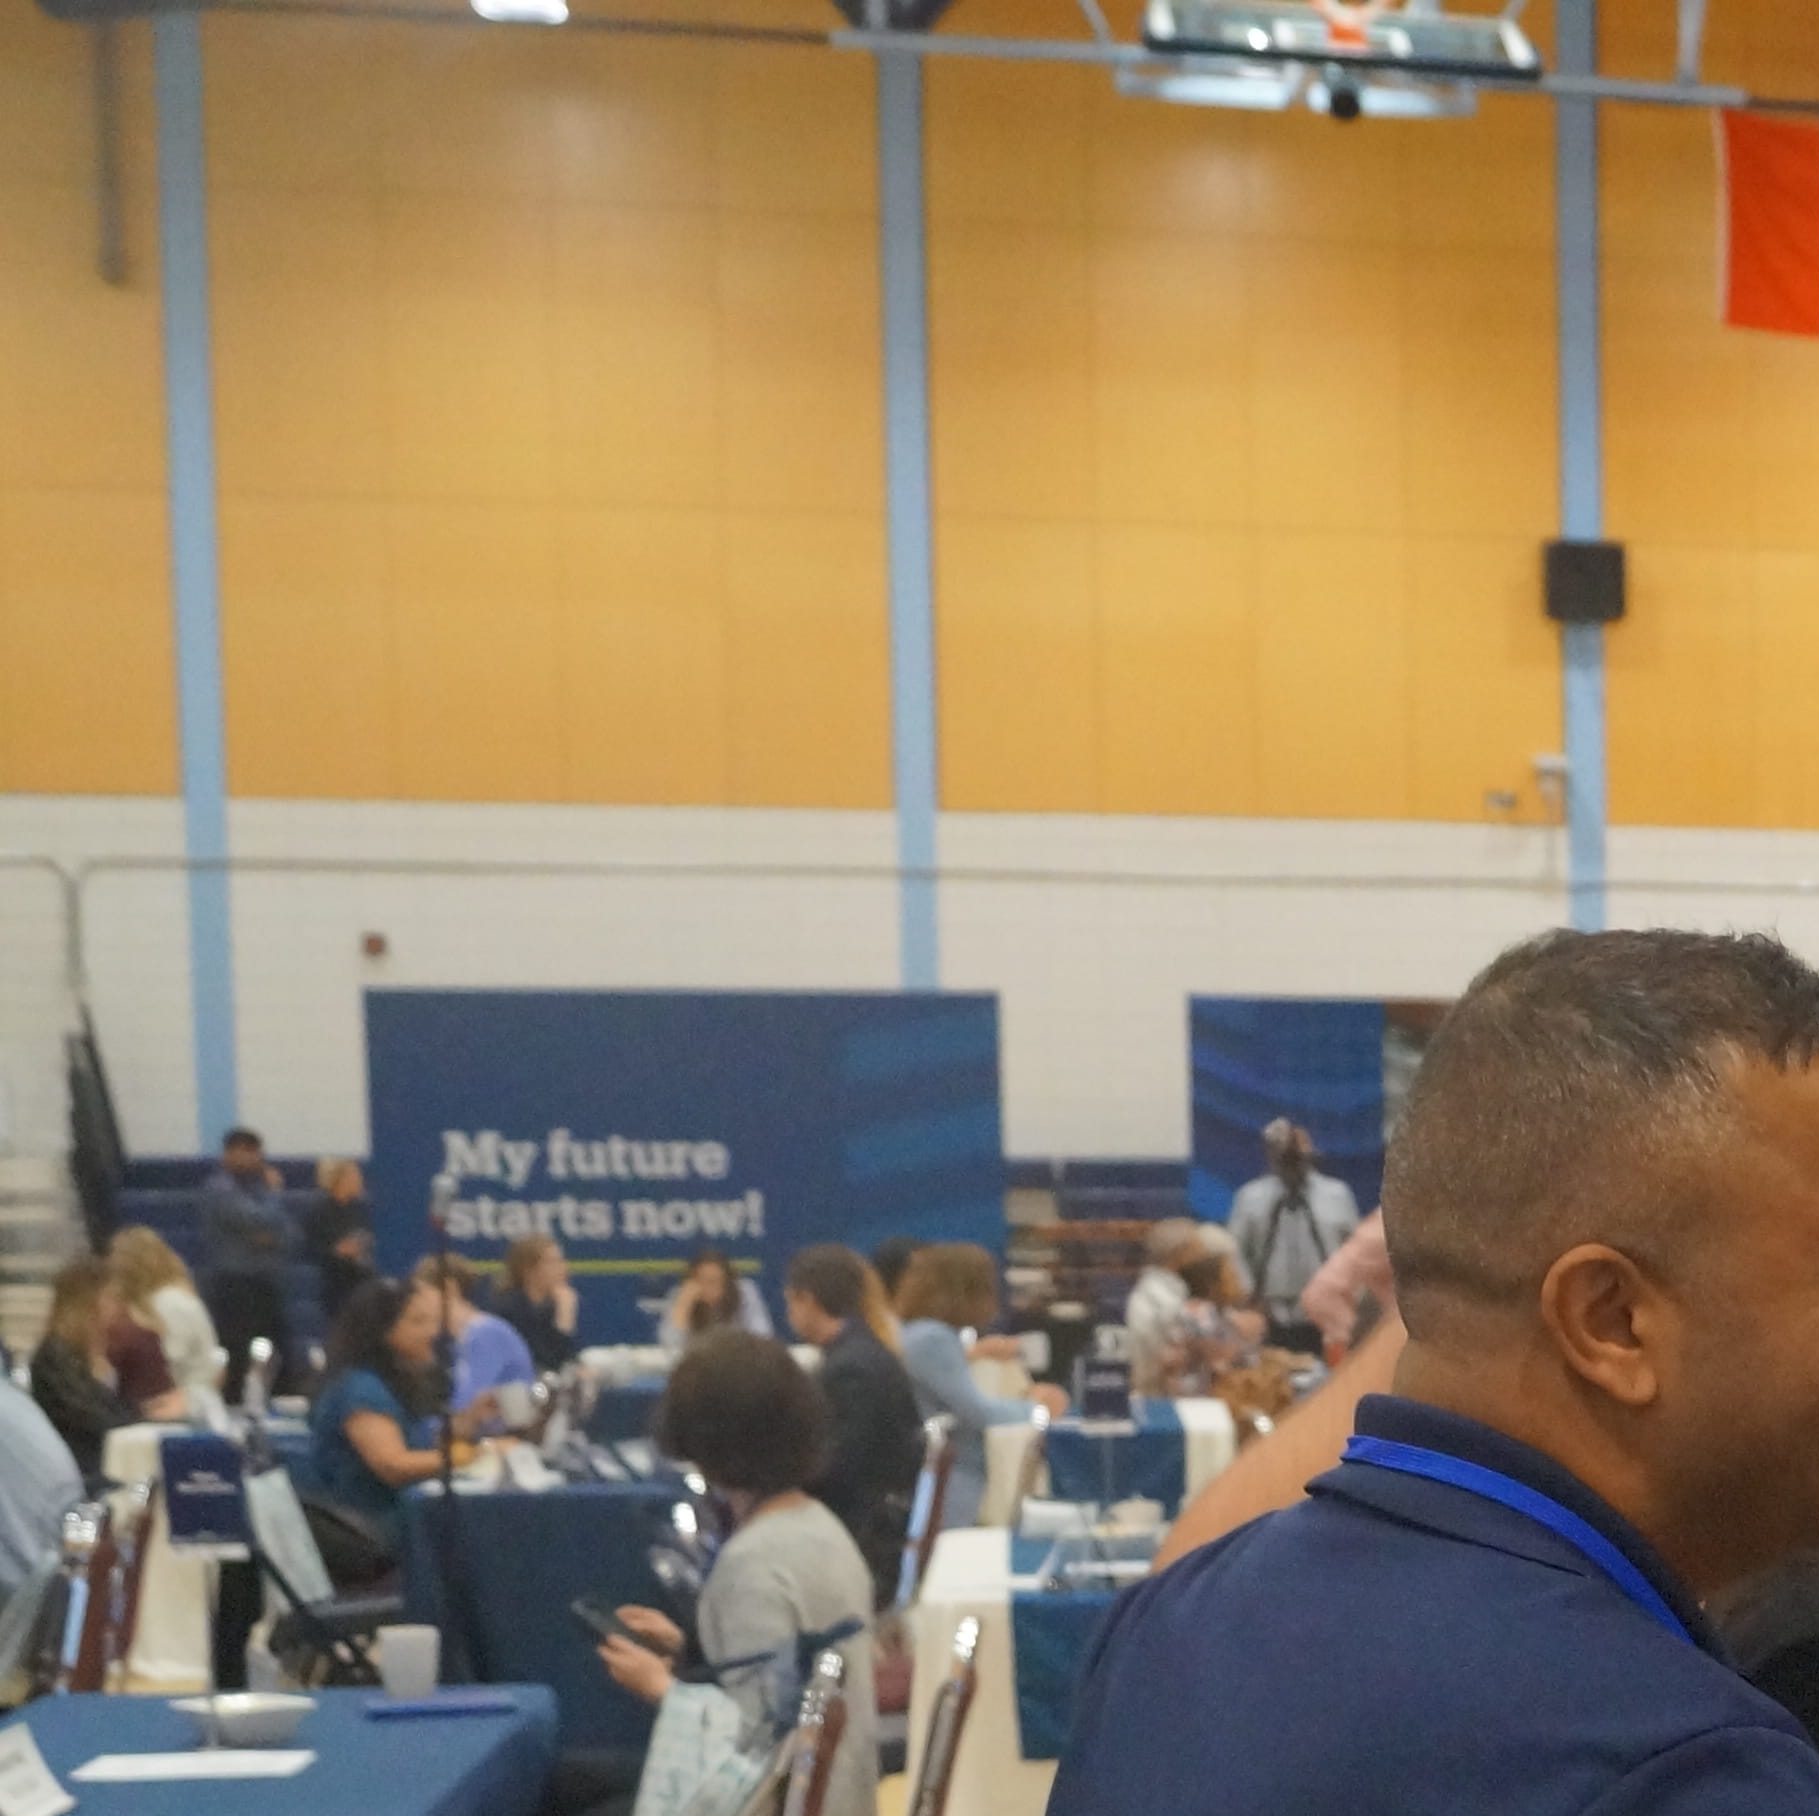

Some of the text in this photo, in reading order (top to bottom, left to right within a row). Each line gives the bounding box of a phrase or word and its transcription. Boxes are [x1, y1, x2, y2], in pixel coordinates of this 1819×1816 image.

[441, 1127, 730, 1189] My future
[445, 1189, 765, 1240] starts now!
